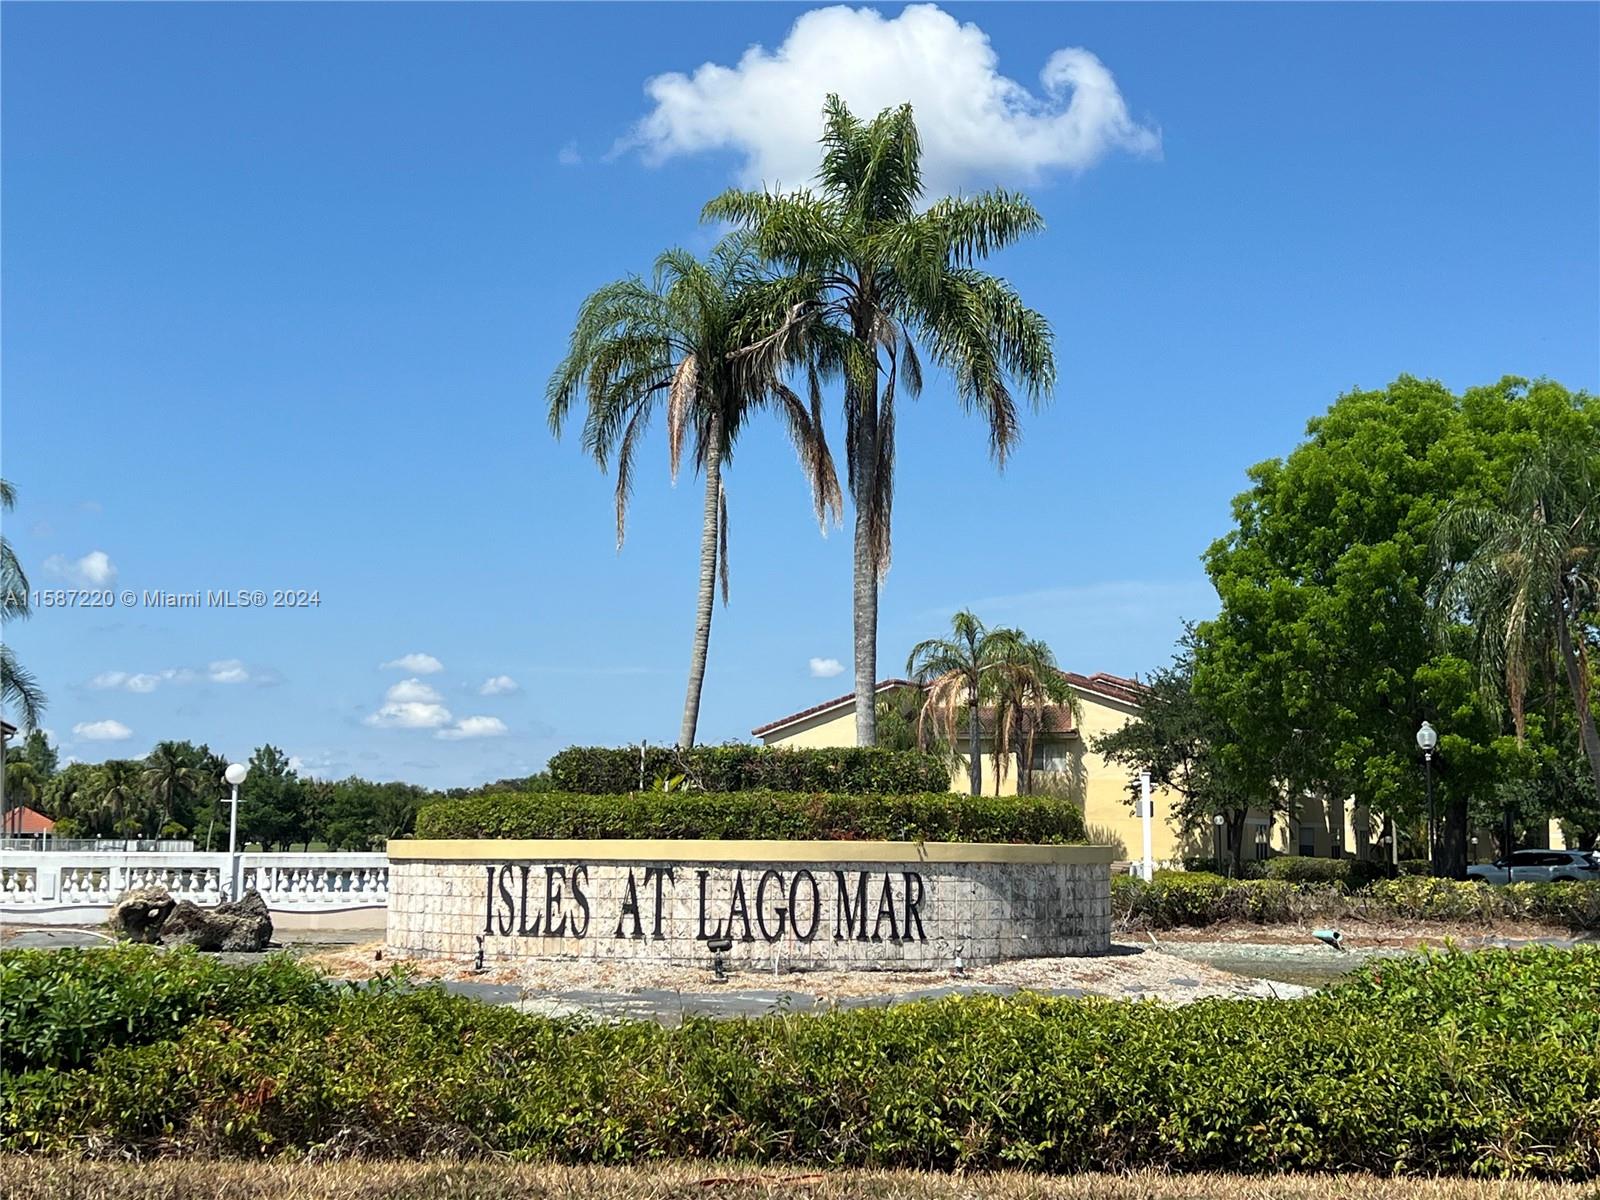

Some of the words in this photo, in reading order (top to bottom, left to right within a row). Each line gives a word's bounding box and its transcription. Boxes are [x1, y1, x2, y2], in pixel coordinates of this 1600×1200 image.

[484, 865, 589, 937] ISLES
[615, 866, 675, 940] AT
[696, 869, 821, 943] LAGO
[833, 870, 928, 944] MAR
